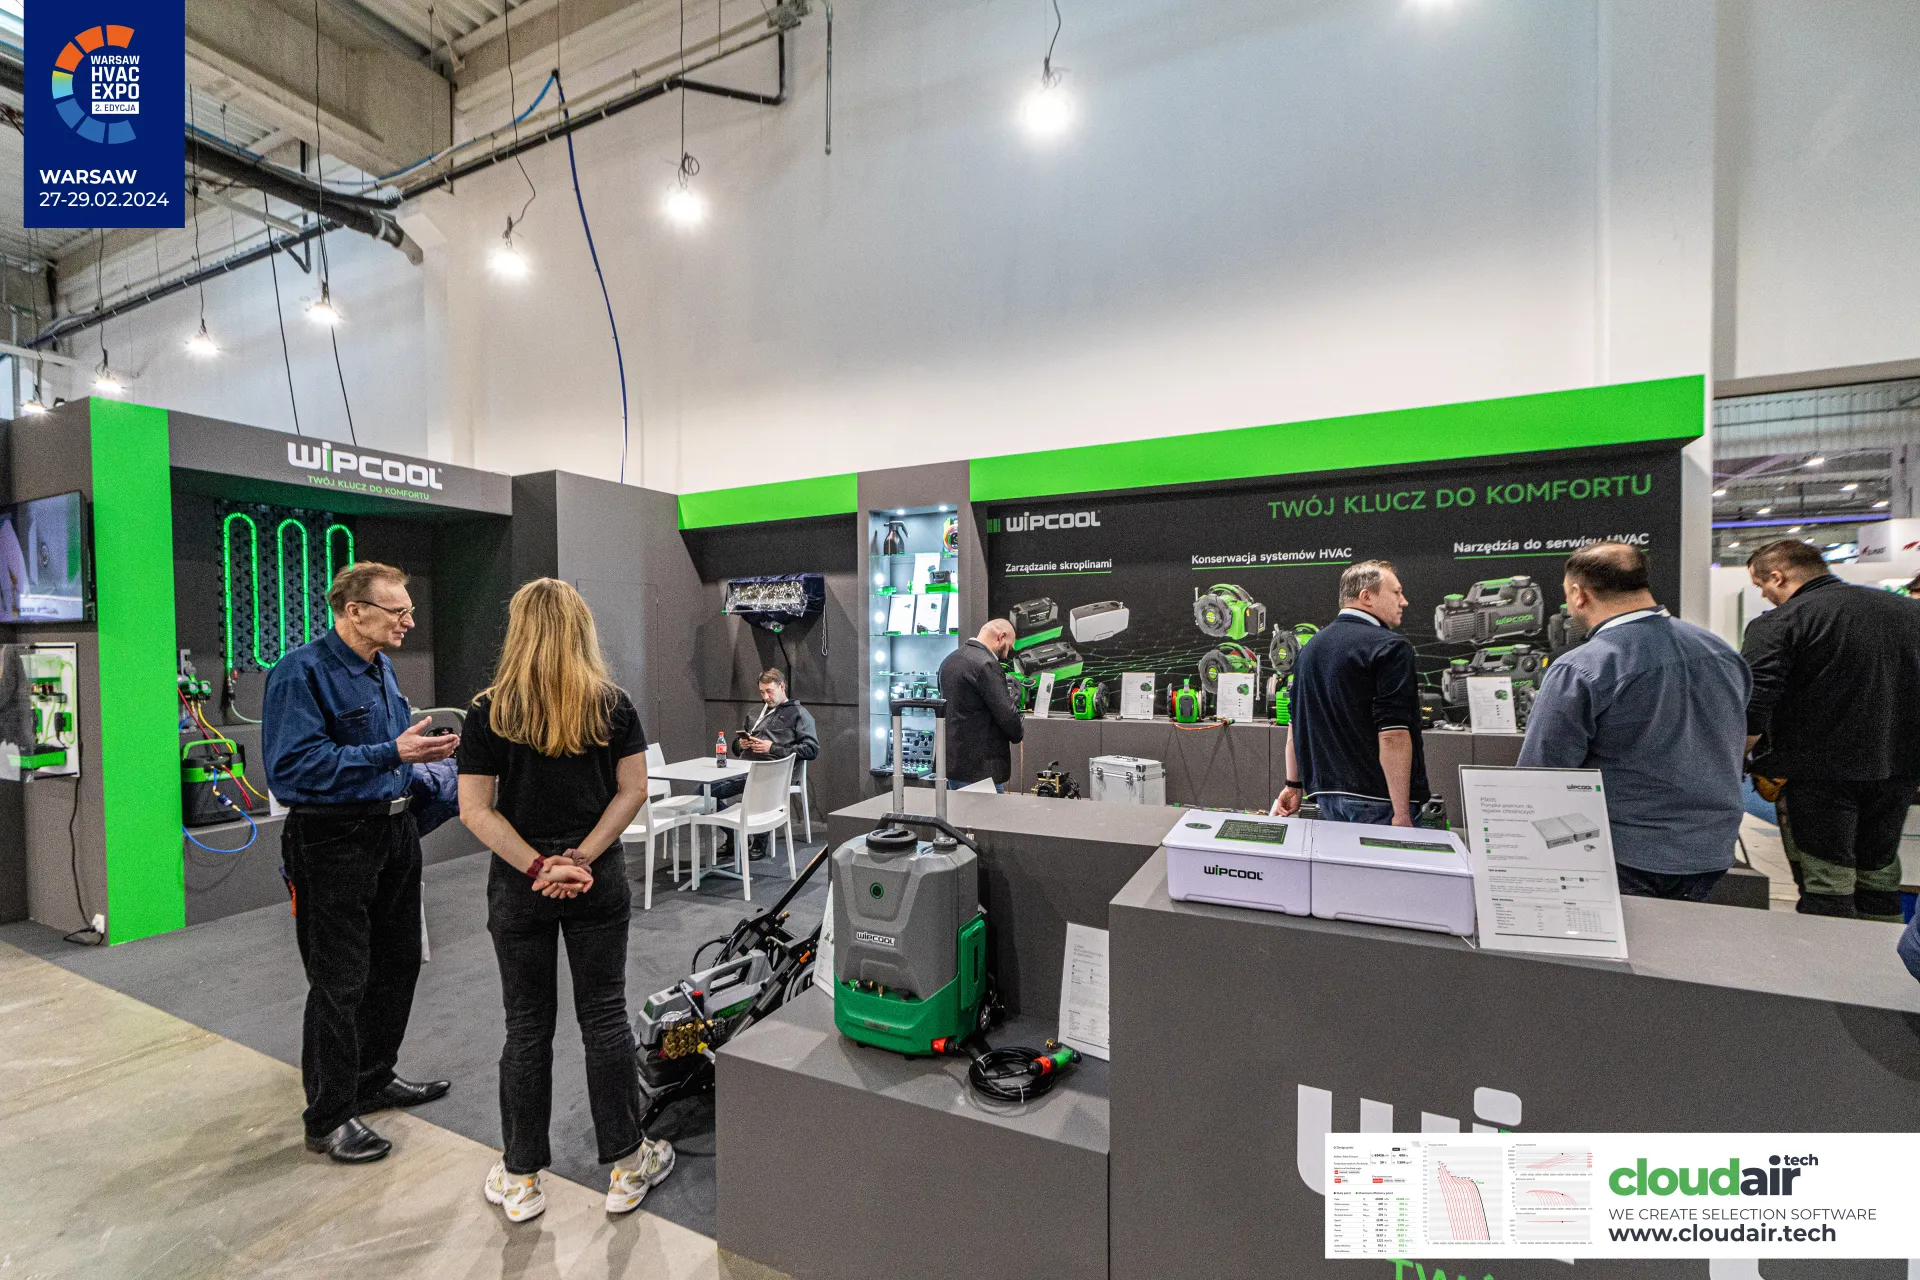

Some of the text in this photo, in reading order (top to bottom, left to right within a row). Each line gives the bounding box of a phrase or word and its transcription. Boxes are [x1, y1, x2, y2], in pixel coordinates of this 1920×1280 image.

[307, 475, 430, 500] TWÓJ KLUCZ DO KOMFORTU
[1267, 473, 1652, 519] TWÓJ KLUCZ DO KOMFORTU
[1453, 538, 1520, 554] Narzędzia
[1523, 538, 1543, 550] do
[1191, 547, 1353, 565] Konserwacja systemów HVAC
[1005, 558, 1113, 574] Zarządzanie skroplinami
